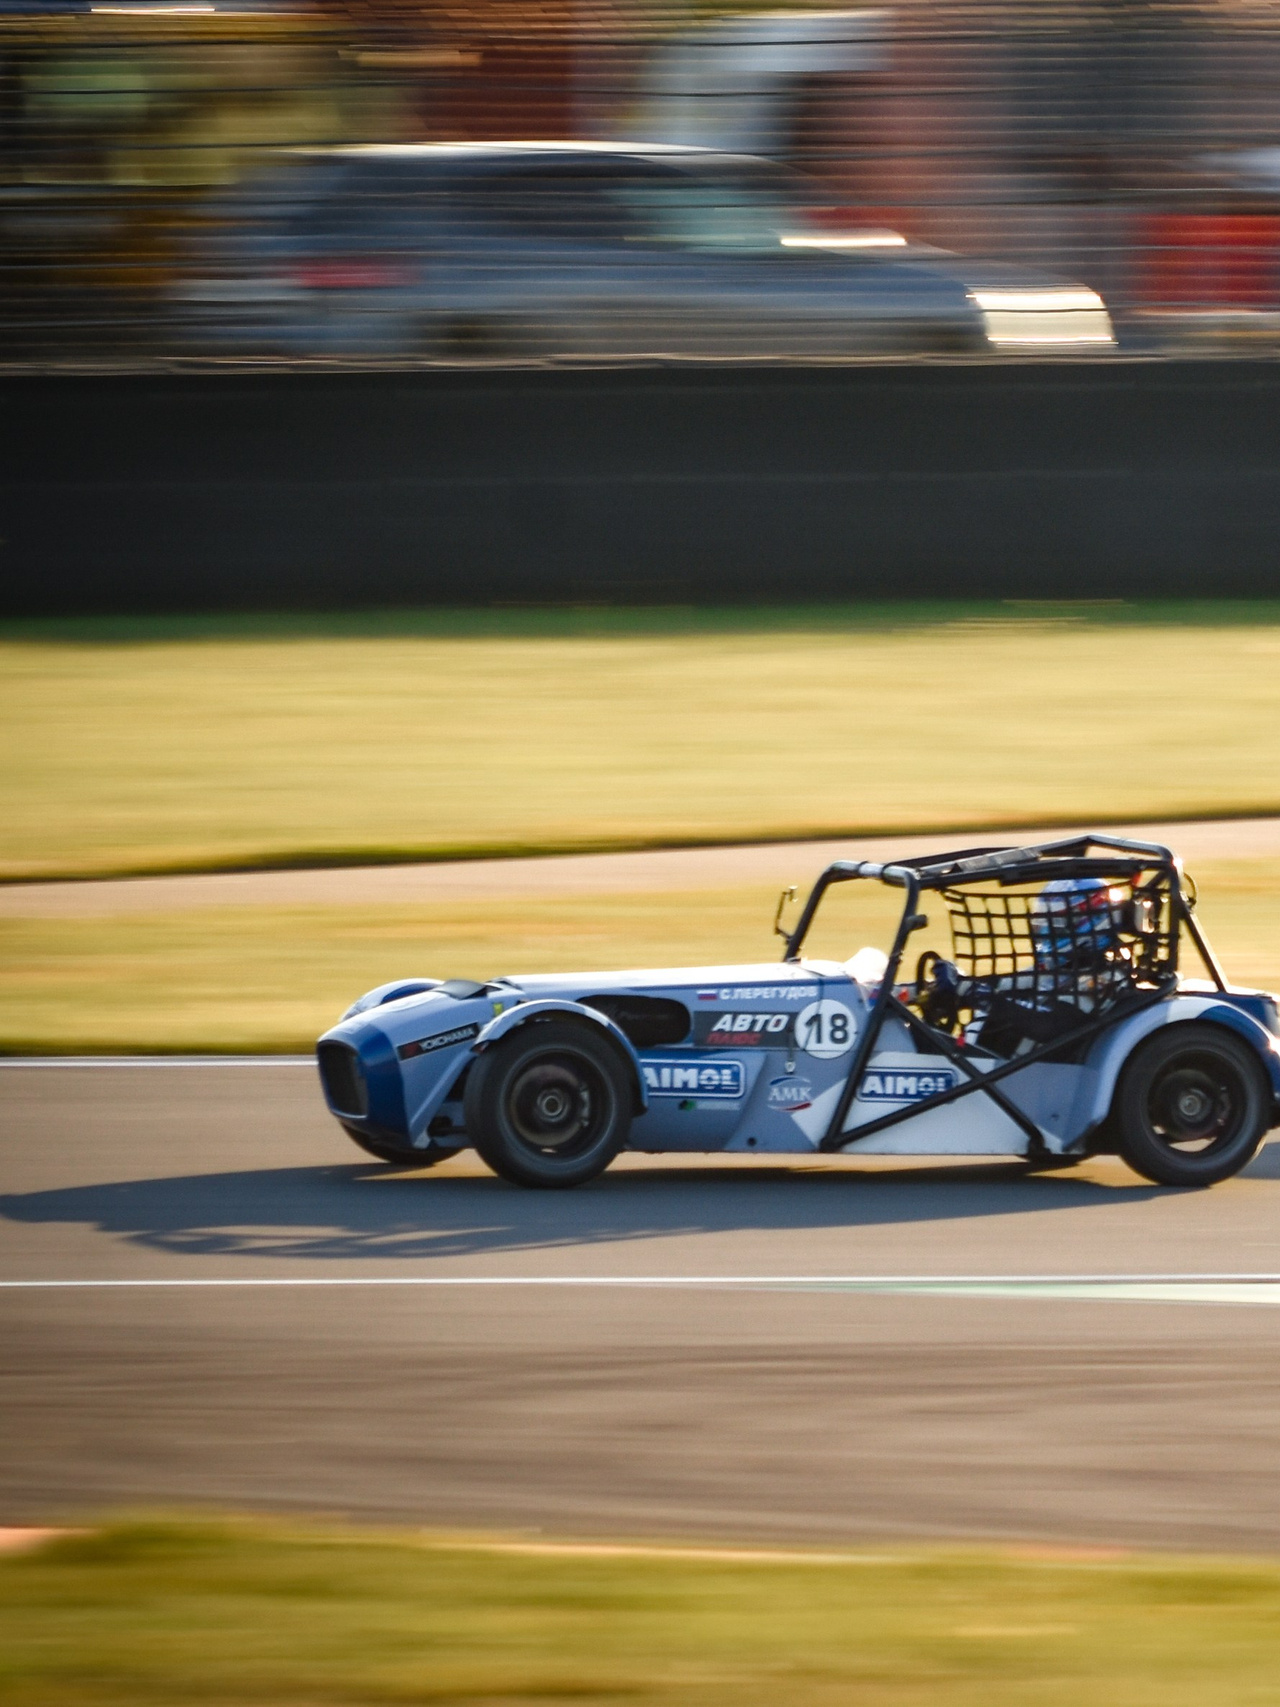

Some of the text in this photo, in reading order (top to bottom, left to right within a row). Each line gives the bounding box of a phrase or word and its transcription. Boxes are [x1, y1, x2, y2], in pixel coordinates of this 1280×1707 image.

[711, 1014, 790, 1033] АВТО
[804, 1013, 849, 1045] 18
[418, 1026, 475, 1052] YOKOHAMA
[642, 1067, 739, 1090] AIMOL
